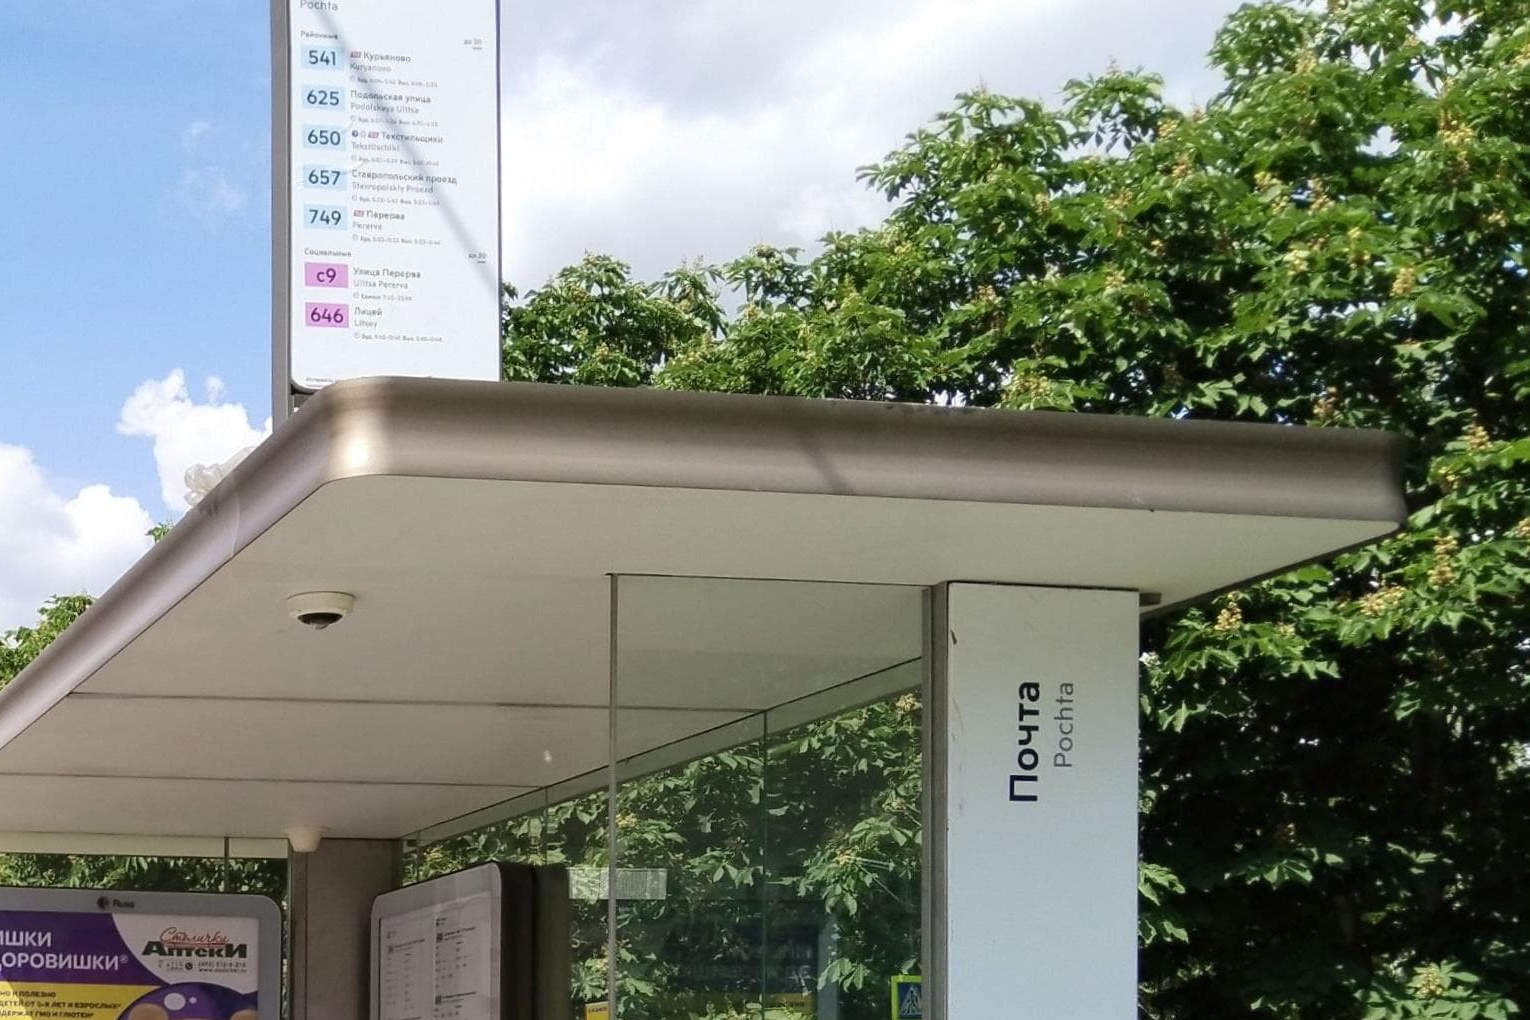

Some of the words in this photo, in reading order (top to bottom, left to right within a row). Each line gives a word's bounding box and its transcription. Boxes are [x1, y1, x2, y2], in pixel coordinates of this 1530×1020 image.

[308, 50, 337, 66] 541
[306, 89, 340, 106] 625
[307, 130, 341, 146] 650
[308, 170, 341, 186] 657
[308, 209, 342, 226] 749
[310, 306, 344, 324] 646
[1054, 682, 1074, 767] Pochta
[1009, 682, 1040, 801] Почта
